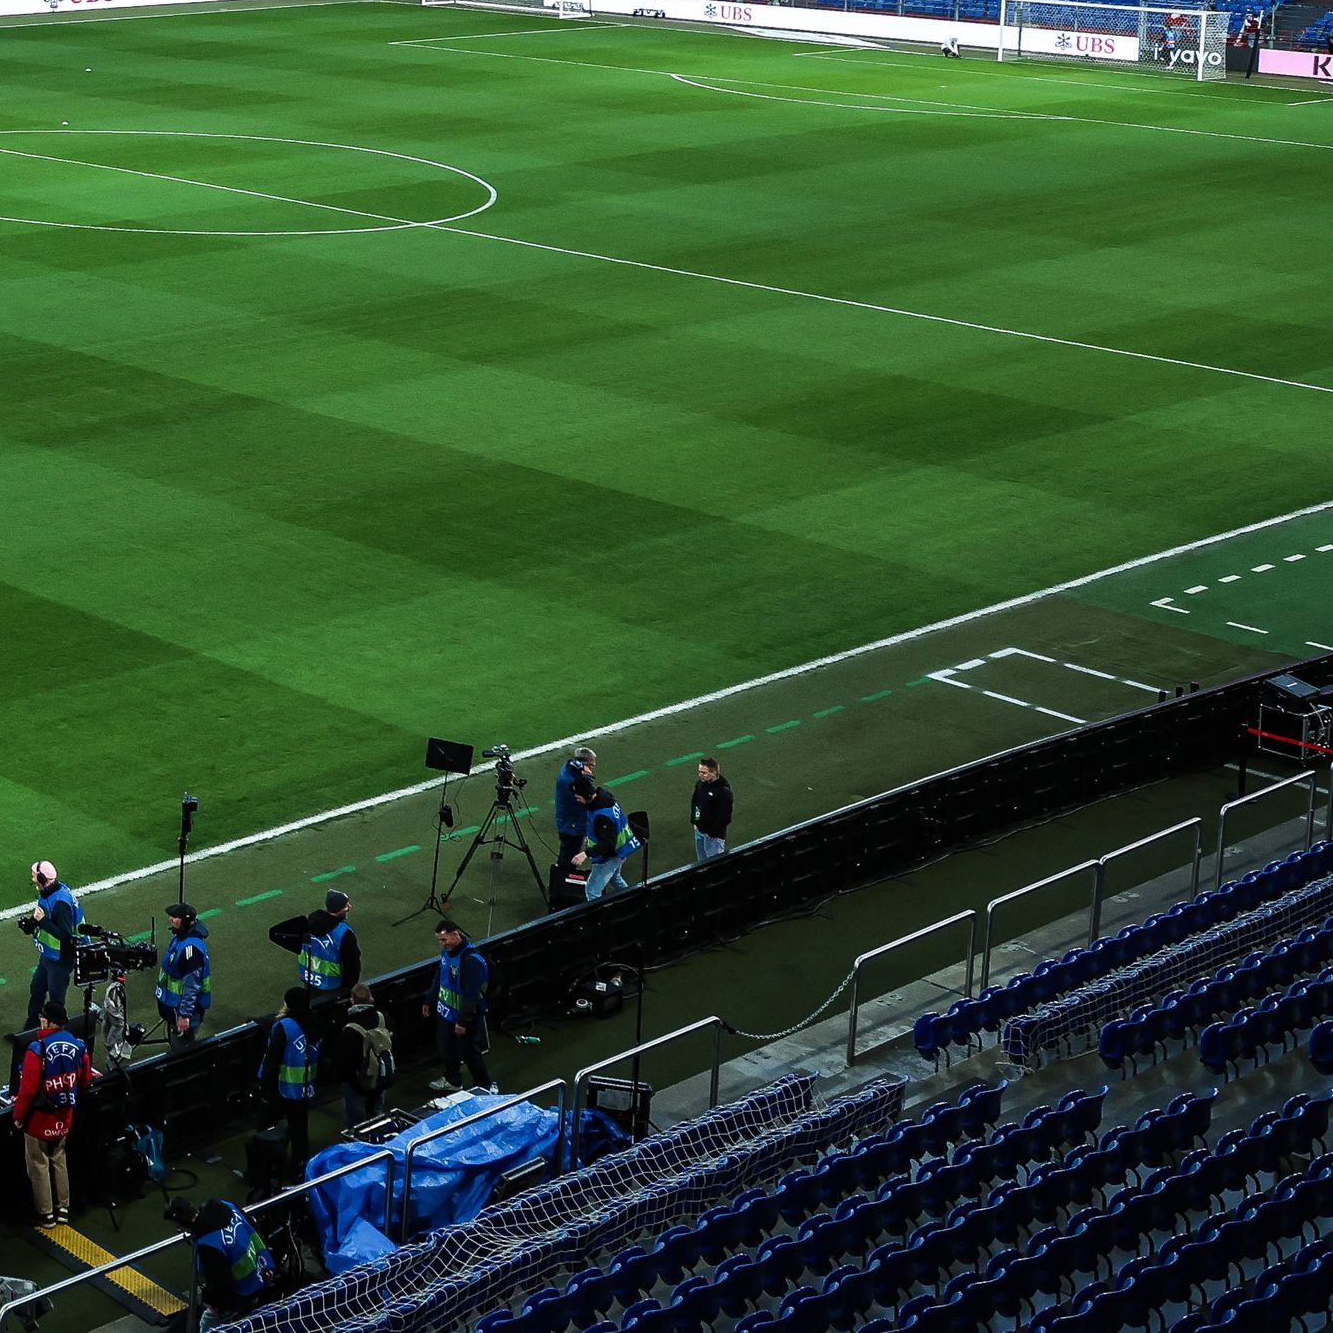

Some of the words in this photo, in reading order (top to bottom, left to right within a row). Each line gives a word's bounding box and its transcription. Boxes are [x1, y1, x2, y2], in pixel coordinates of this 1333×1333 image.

[720, 5, 752, 21] UBS
[1076, 36, 1115, 55] UBS
[46, 1045, 76, 1061] UEFA
